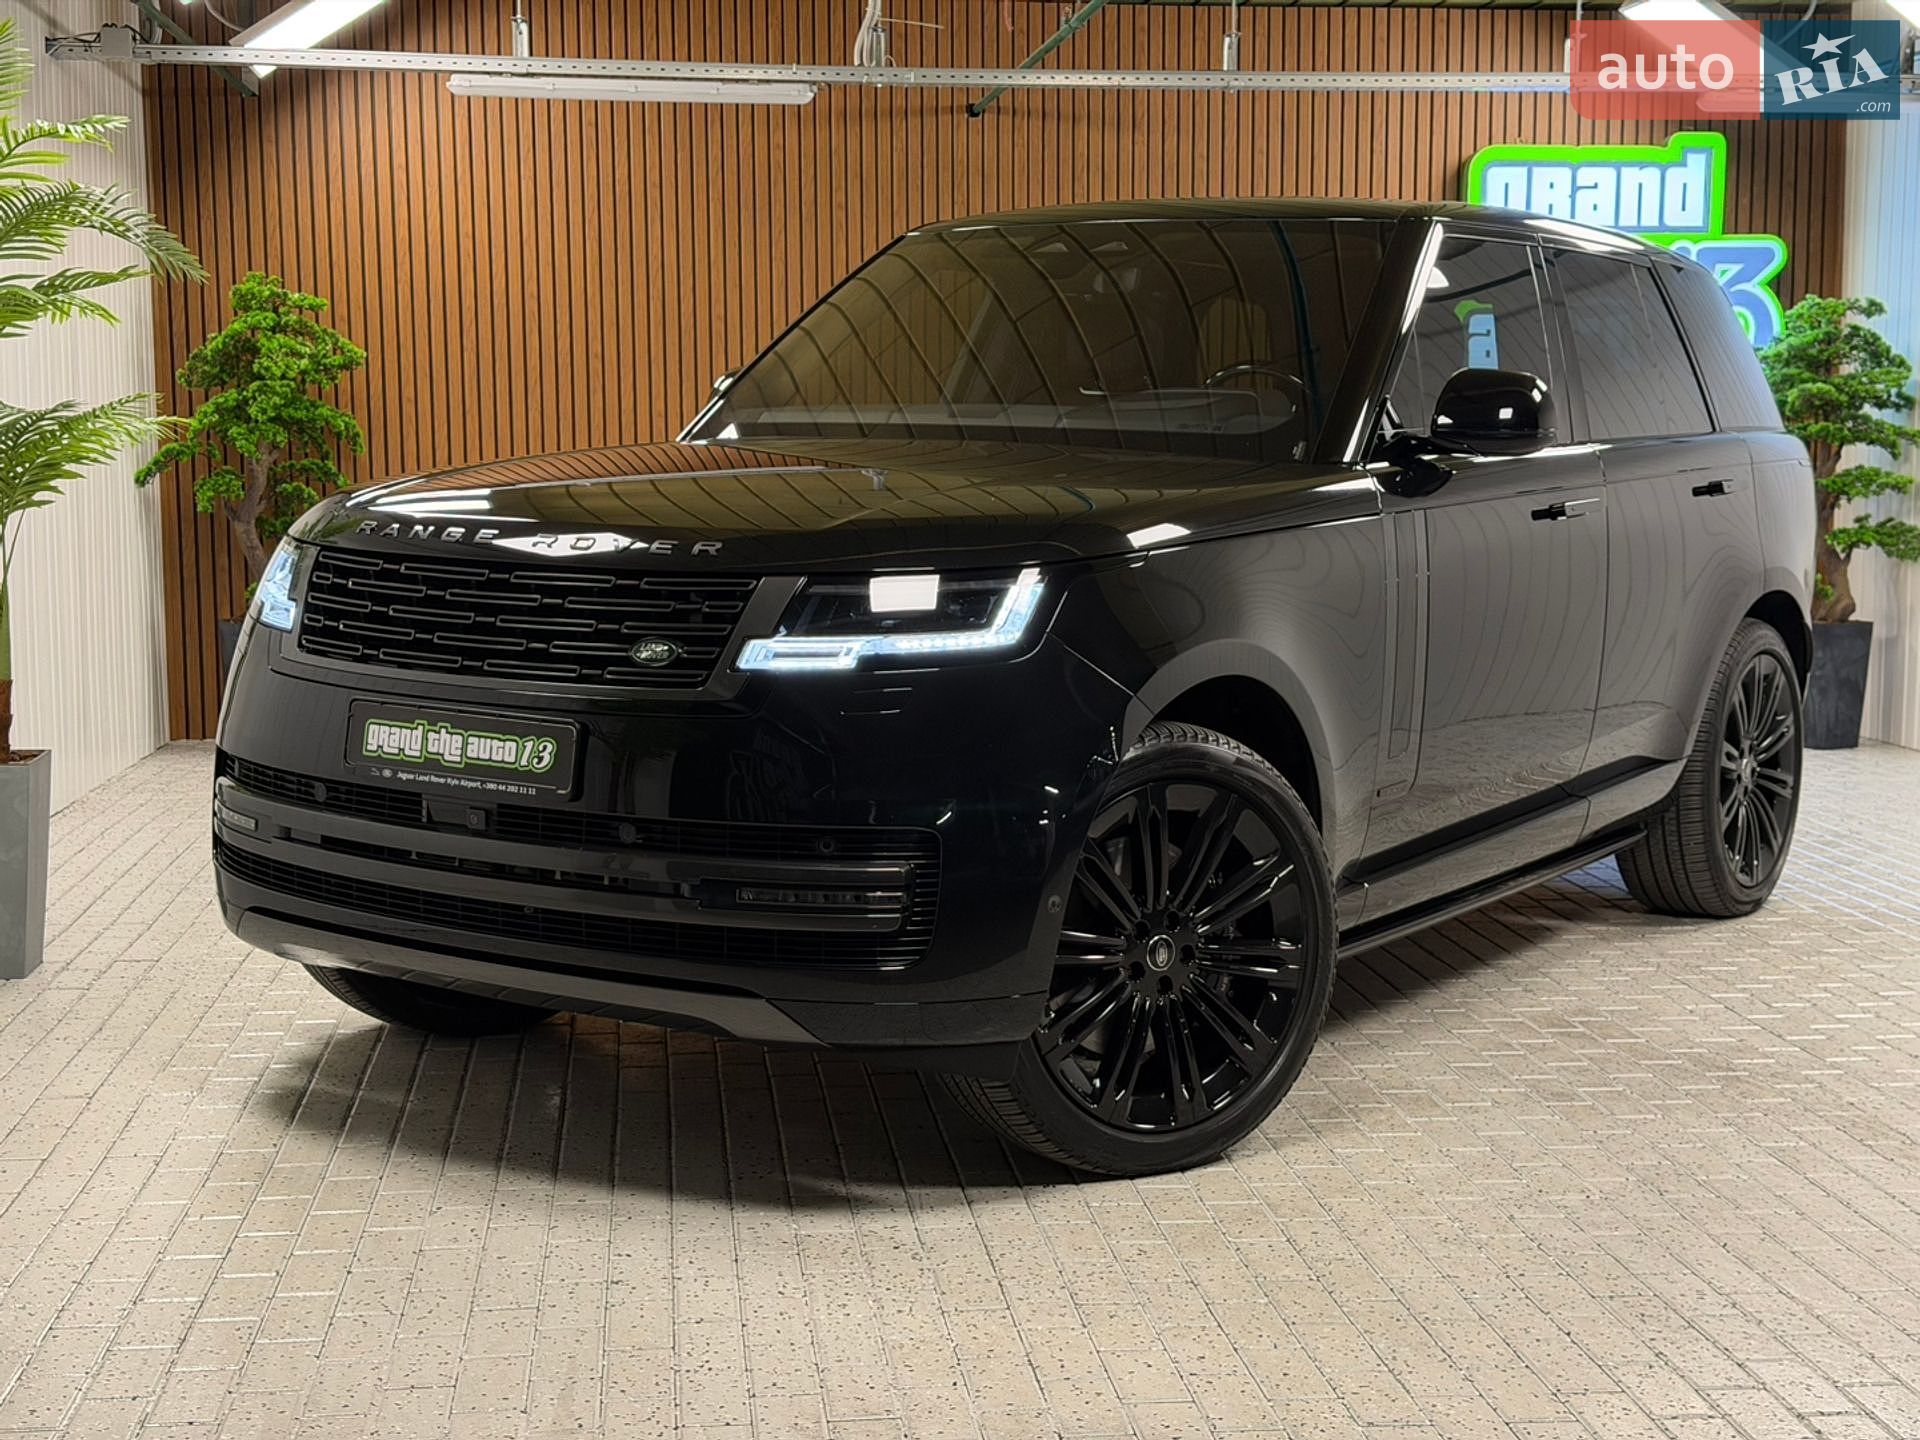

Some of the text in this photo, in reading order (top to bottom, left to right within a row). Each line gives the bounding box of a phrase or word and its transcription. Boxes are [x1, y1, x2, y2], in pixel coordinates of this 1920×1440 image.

[355, 520, 723, 557] RANGE ROVER
[366, 724, 554, 768] grand the auto 13
[415, 772, 429, 782] Land
[430, 774, 446, 784] Rover
